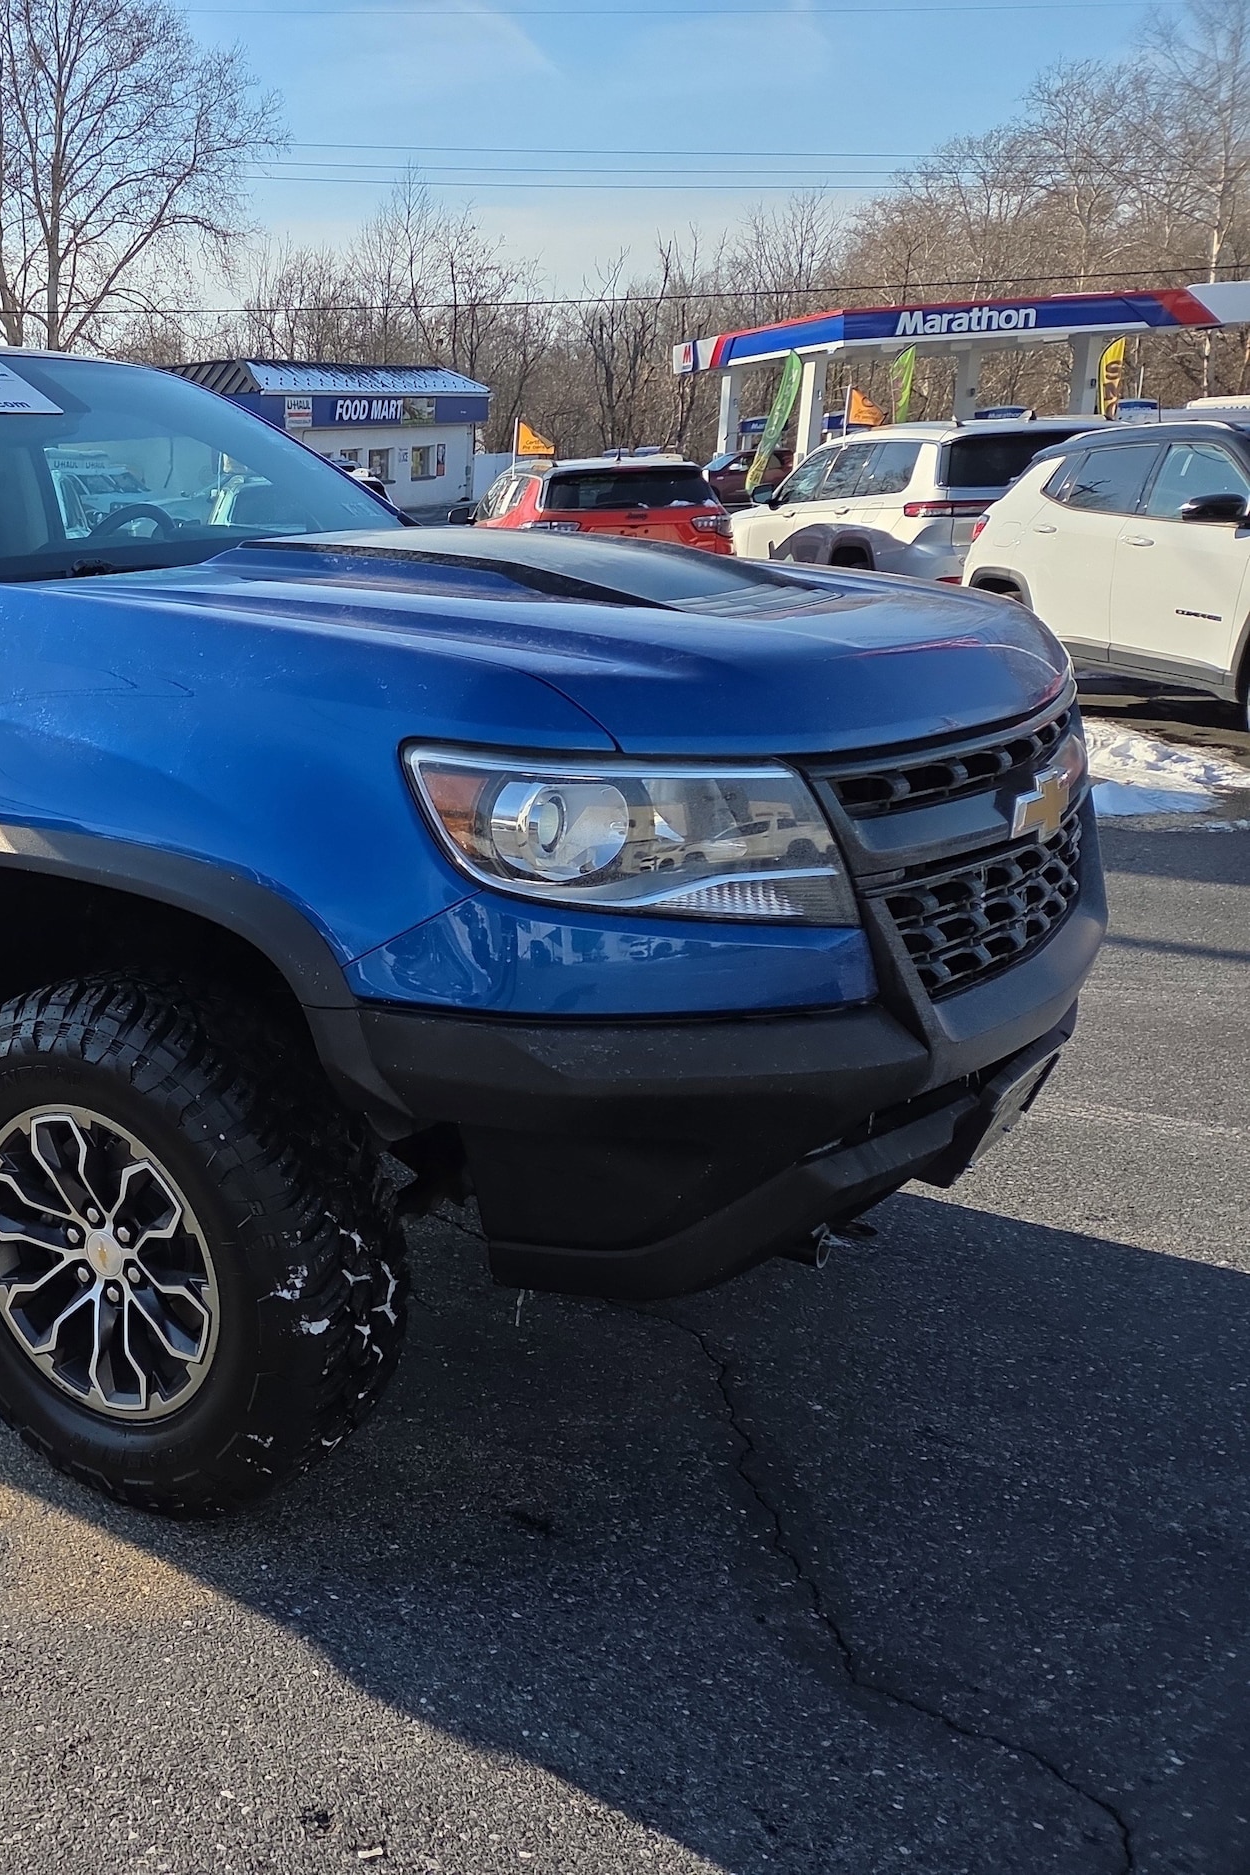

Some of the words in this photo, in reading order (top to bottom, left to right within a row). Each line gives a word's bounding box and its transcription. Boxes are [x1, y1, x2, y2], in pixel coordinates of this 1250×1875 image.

[895, 306, 1037, 336] Marathon
[335, 399, 369, 421] FOOD
[370, 399, 403, 420] MART
